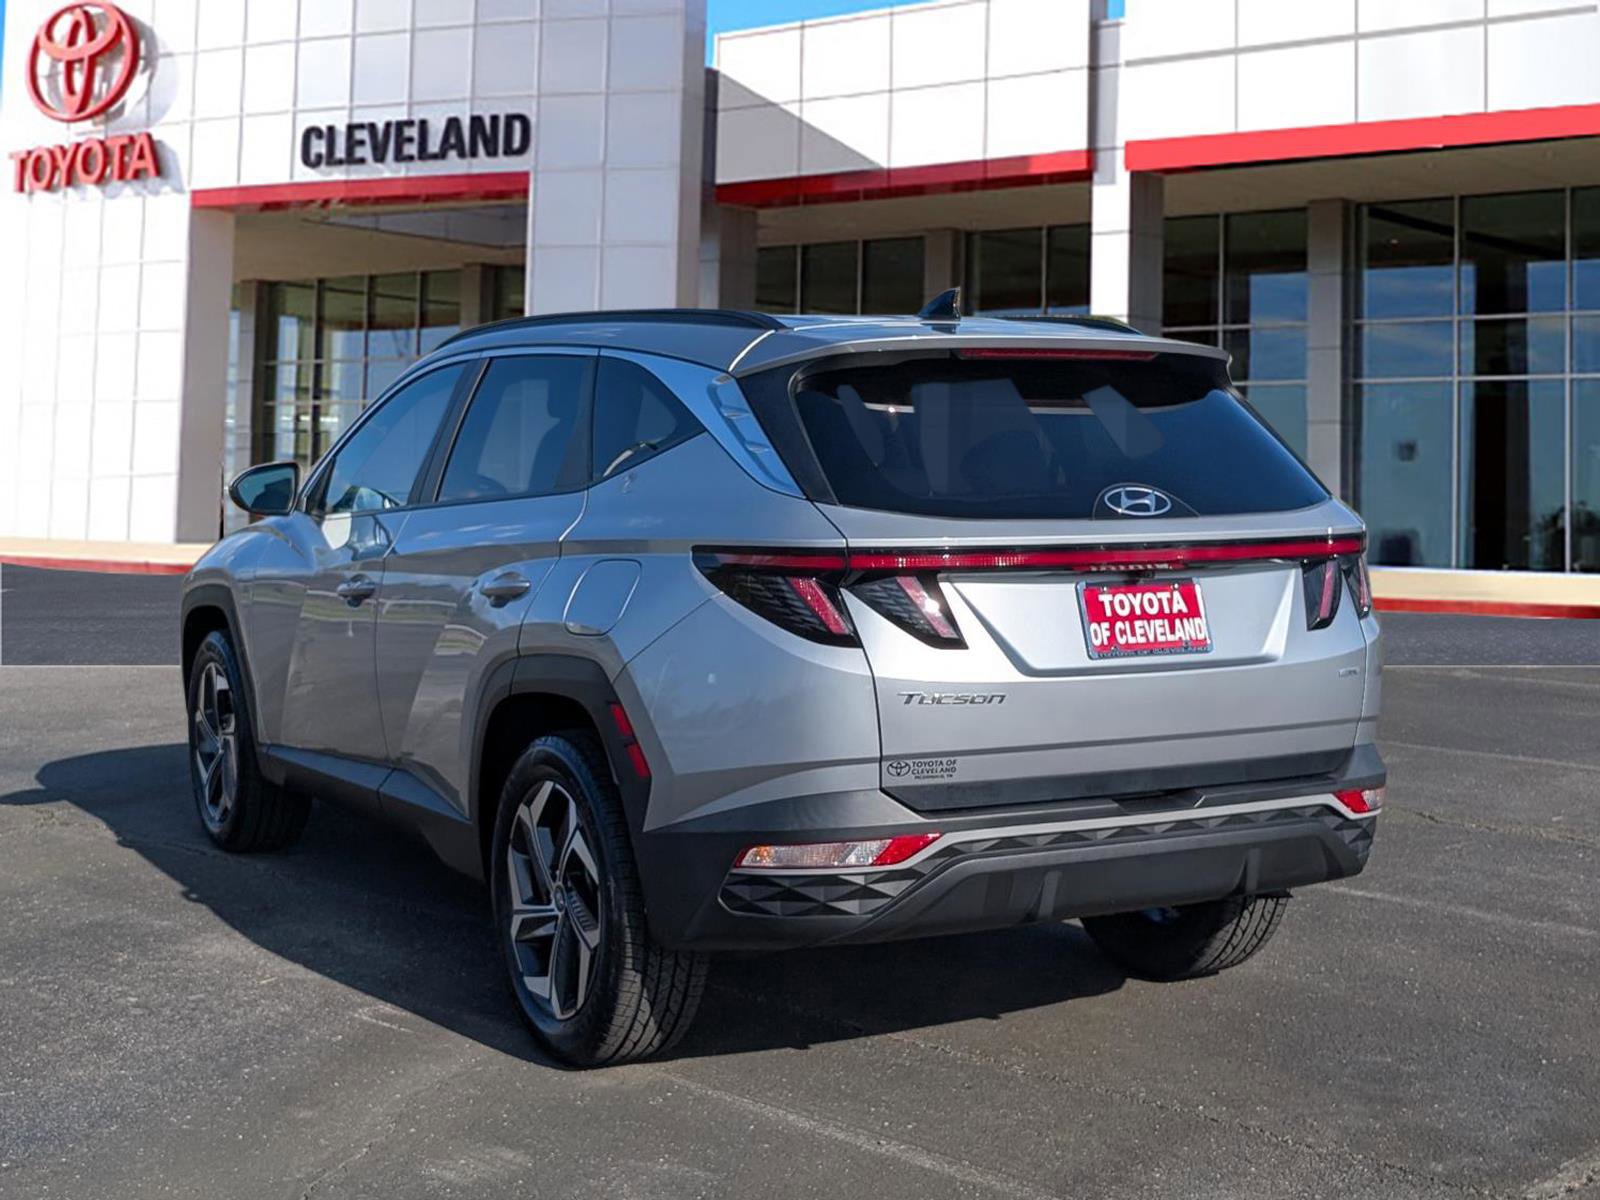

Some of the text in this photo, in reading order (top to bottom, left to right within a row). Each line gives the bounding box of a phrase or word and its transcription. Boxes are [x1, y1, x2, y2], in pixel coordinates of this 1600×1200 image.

[301, 113, 531, 169] CLEVELAND
[9, 131, 161, 193] TOYOTA
[1098, 590, 1188, 617] TOYOTA
[1089, 616, 1207, 646] OF CLEVELAND
[911, 759, 957, 768] TOYOTA OF
[911, 766, 957, 775] CLEVELAND
